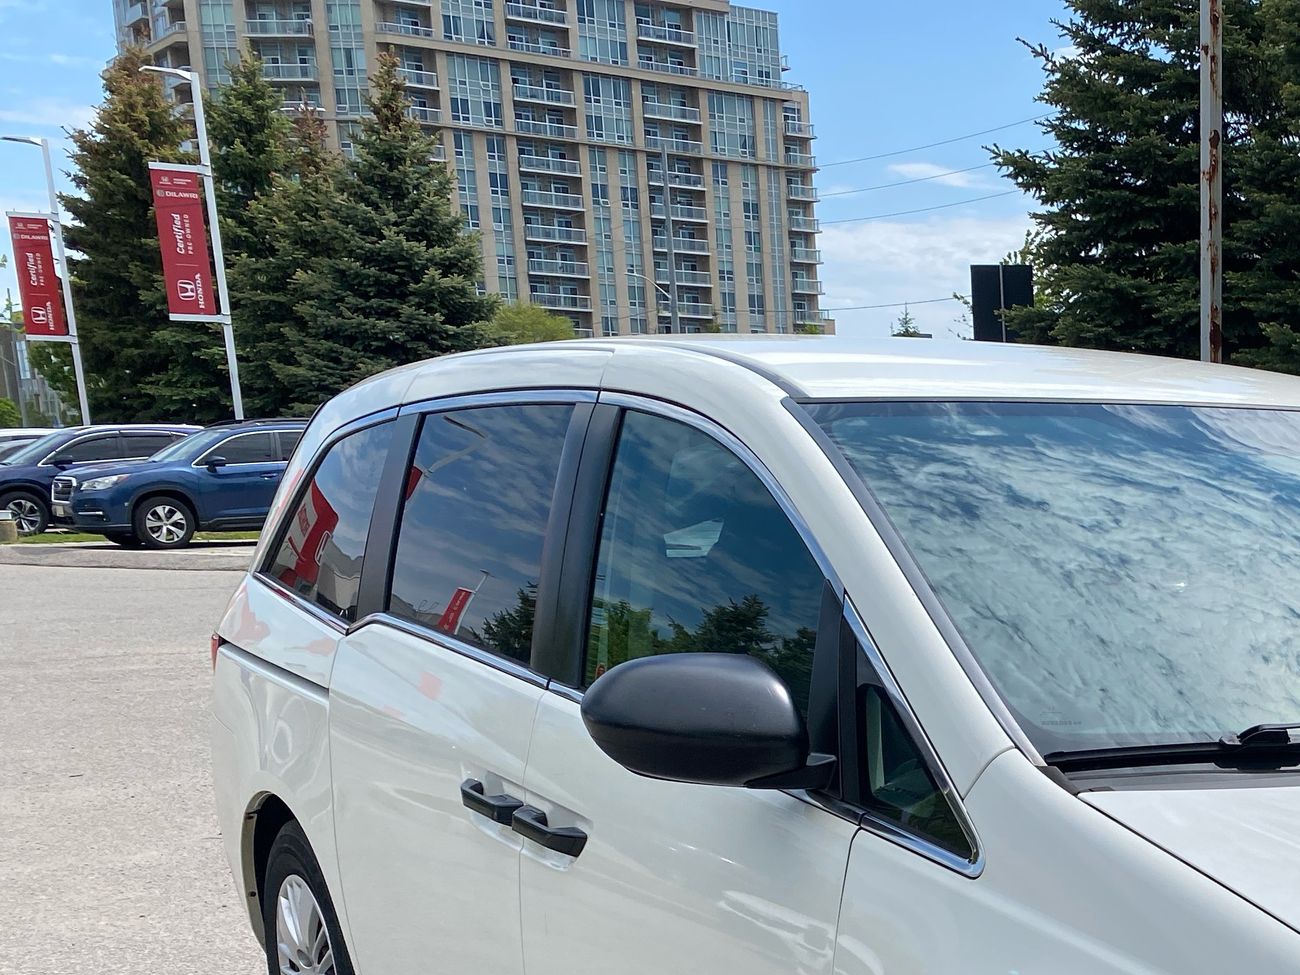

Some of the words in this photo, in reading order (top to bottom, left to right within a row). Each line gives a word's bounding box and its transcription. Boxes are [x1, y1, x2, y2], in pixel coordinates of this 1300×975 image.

[165, 190, 198, 199] DILAWRI
[171, 213, 185, 254] Certified
[25, 252, 38, 286] Certified
[195, 273, 205, 309] HONDA
